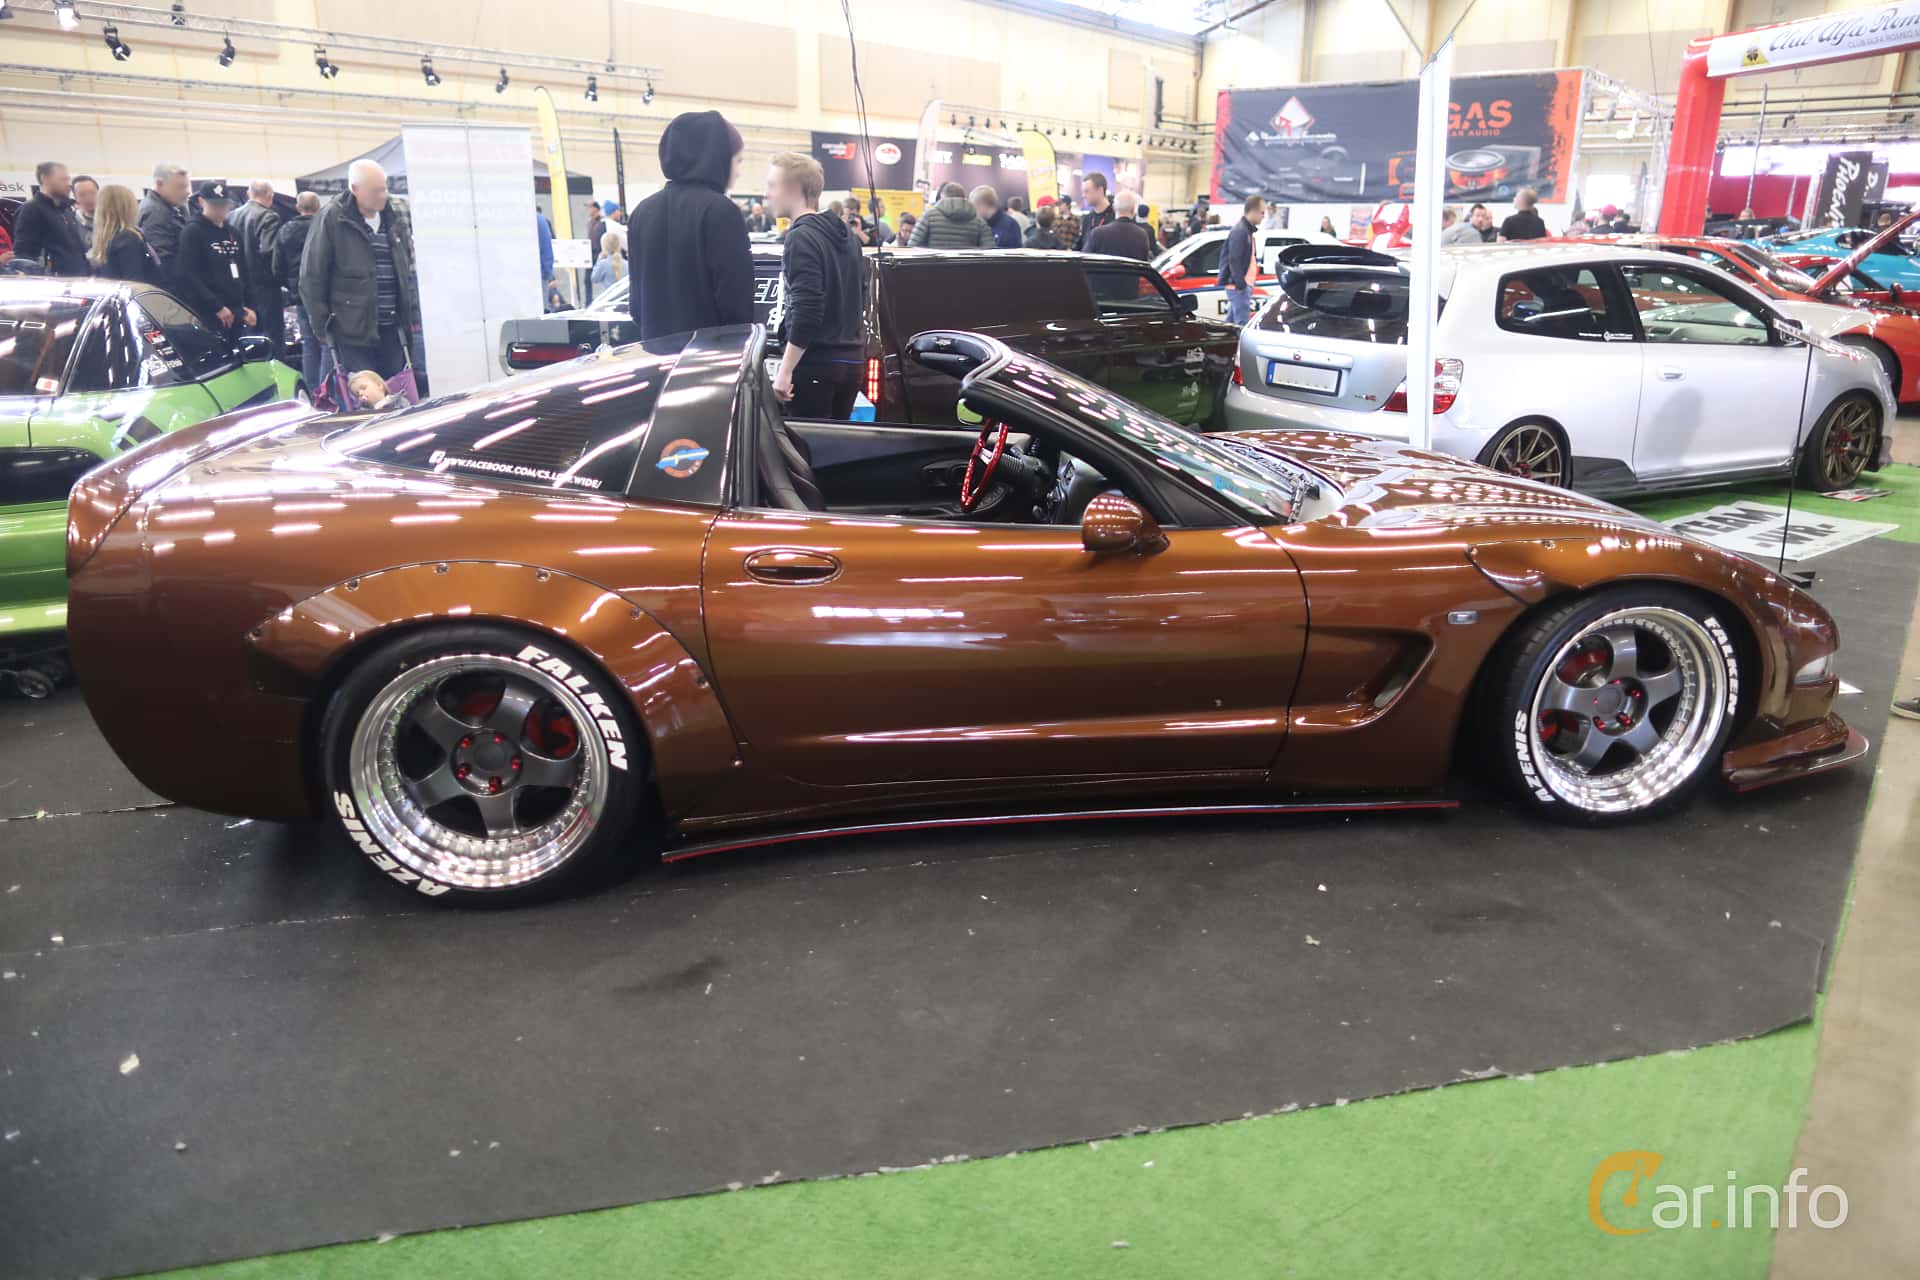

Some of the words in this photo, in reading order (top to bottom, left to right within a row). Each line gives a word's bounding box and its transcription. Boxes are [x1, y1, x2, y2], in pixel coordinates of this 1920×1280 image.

[1448, 99, 1512, 129] GAS
[1671, 497, 1783, 537] TEAM
[516, 645, 628, 770] FALKEN
[1703, 616, 1739, 715] FALKEN
[1515, 709, 1556, 802] AZENIS
[333, 791, 451, 896] AZENIS
